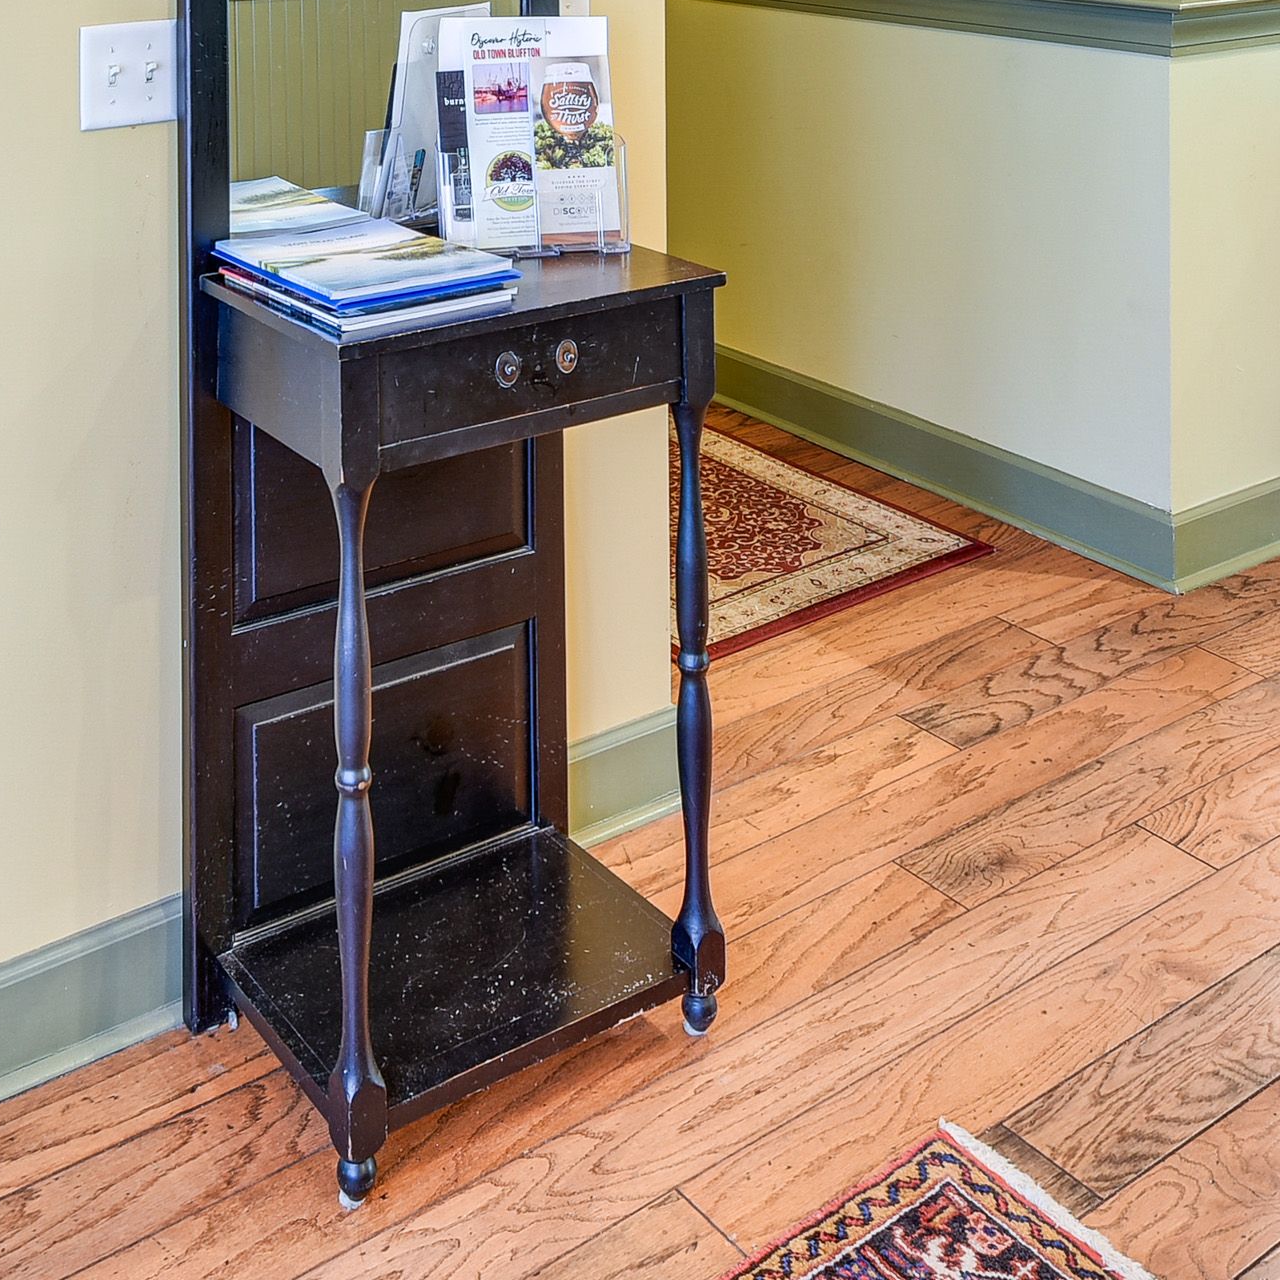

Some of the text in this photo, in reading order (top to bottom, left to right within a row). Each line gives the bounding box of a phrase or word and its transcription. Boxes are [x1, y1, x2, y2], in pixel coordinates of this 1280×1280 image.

[470, 27, 543, 49] Discover Historic
[472, 47, 541, 60] OLD TOWN BLUFFTON
[444, 96, 465, 106] burn
[548, 92, 592, 109] Satisfy
[552, 206, 596, 216] DISCOVE
